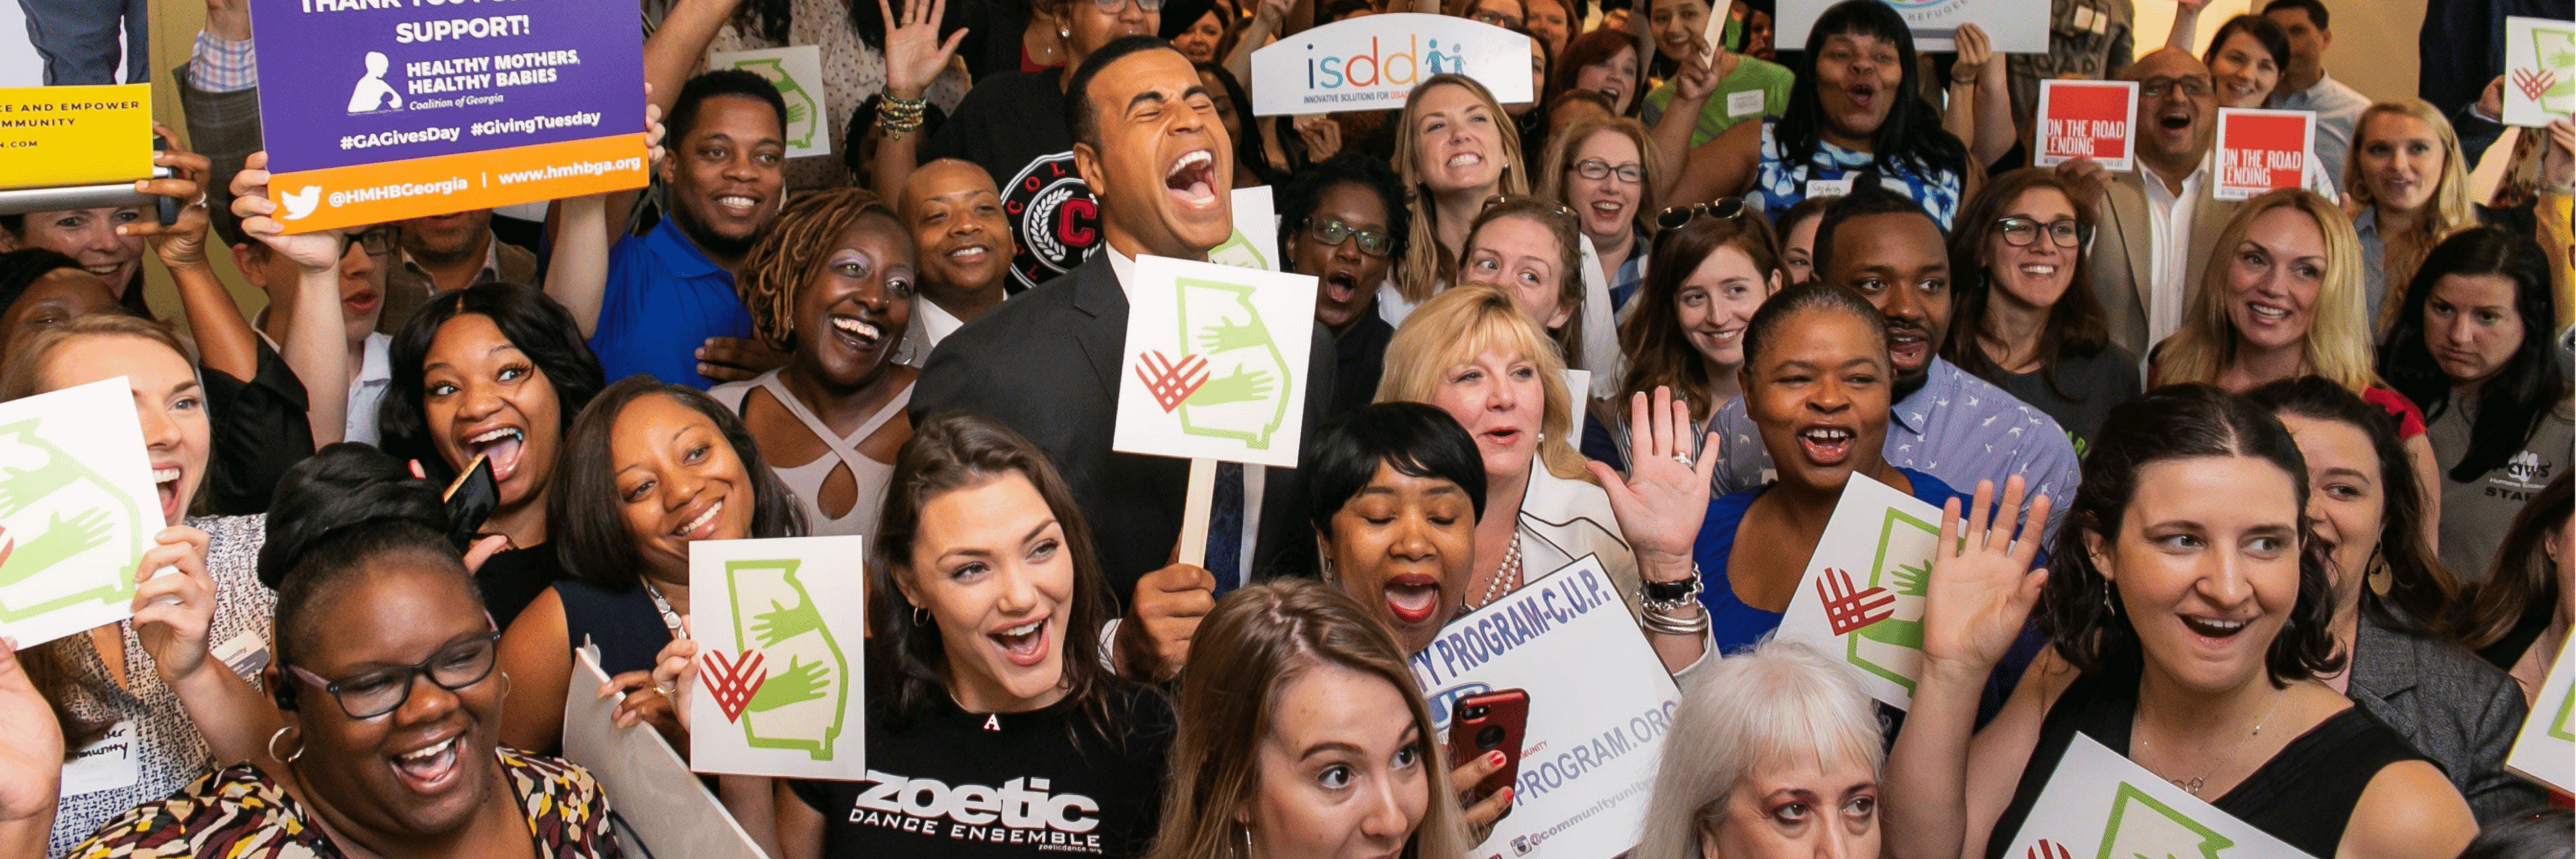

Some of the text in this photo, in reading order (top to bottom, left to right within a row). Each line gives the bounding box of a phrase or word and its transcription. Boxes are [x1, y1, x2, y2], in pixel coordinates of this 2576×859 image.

[396, 14, 530, 43] SUPPORT!
[406, 49, 580, 78] HEALTHY MOTHERS,
[1307, 34, 1418, 89] isdd
[408, 68, 557, 95] HEALTHY BABIES
[21, 104, 54, 112] AND
[60, 101, 139, 111] EMPOWER
[409, 93, 504, 111] Coalition of Georgia
[1303, 93, 1339, 104] INNOVATIVE
[1340, 91, 1375, 102] SOLUTIONS
[1376, 91, 1389, 100] FOR
[340, 111, 602, 150] #GAGivesDay #GivingTuesday
[2047, 118, 2125, 140] ON THE ROAD
[2046, 136, 2094, 155] LENDING
[2241, 149, 2264, 168] THE
[2267, 150, 2302, 171] ROAD
[328, 175, 468, 208] @HMHBGeorgia
[498, 155, 642, 185] www.hmhbga.org
[2223, 166, 2271, 186] LENDING
[1059, 197, 1098, 247] C
[984, 713, 1001, 731] A
[855, 768, 1100, 833] zoetic
[848, 809, 1100, 848] DANCE ENSEMBLE
